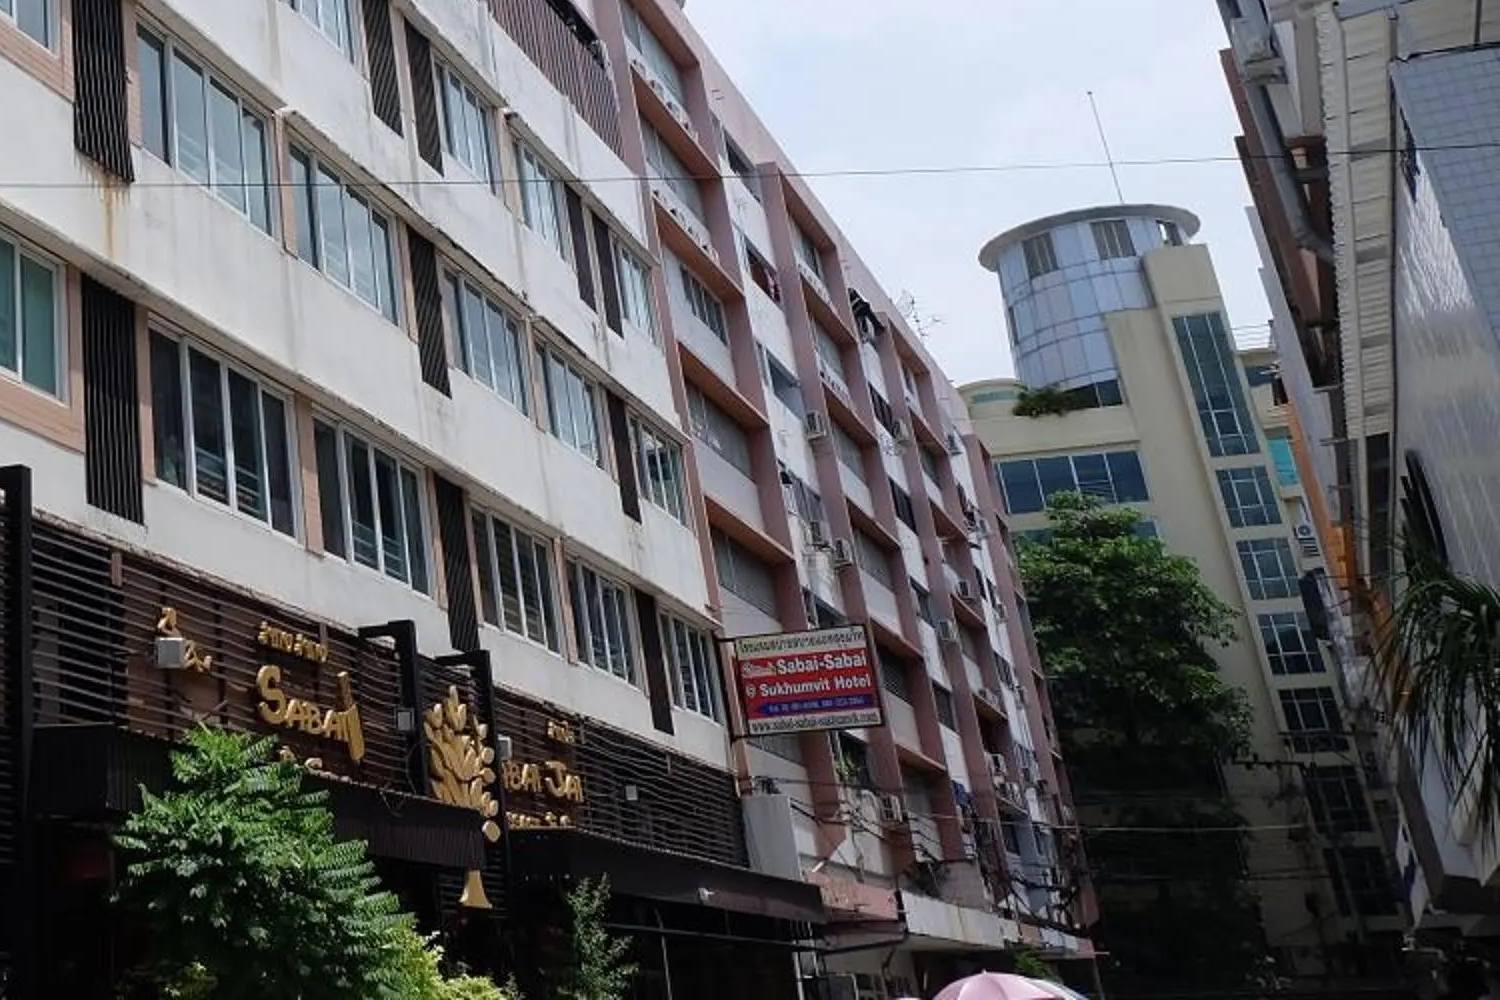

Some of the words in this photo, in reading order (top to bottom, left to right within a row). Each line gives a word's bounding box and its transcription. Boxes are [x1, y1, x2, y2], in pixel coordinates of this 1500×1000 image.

[776, 650, 867, 675] Sabai-Sabai
[759, 677, 831, 697] Sukhumvit
[834, 674, 871, 689] Hotel
